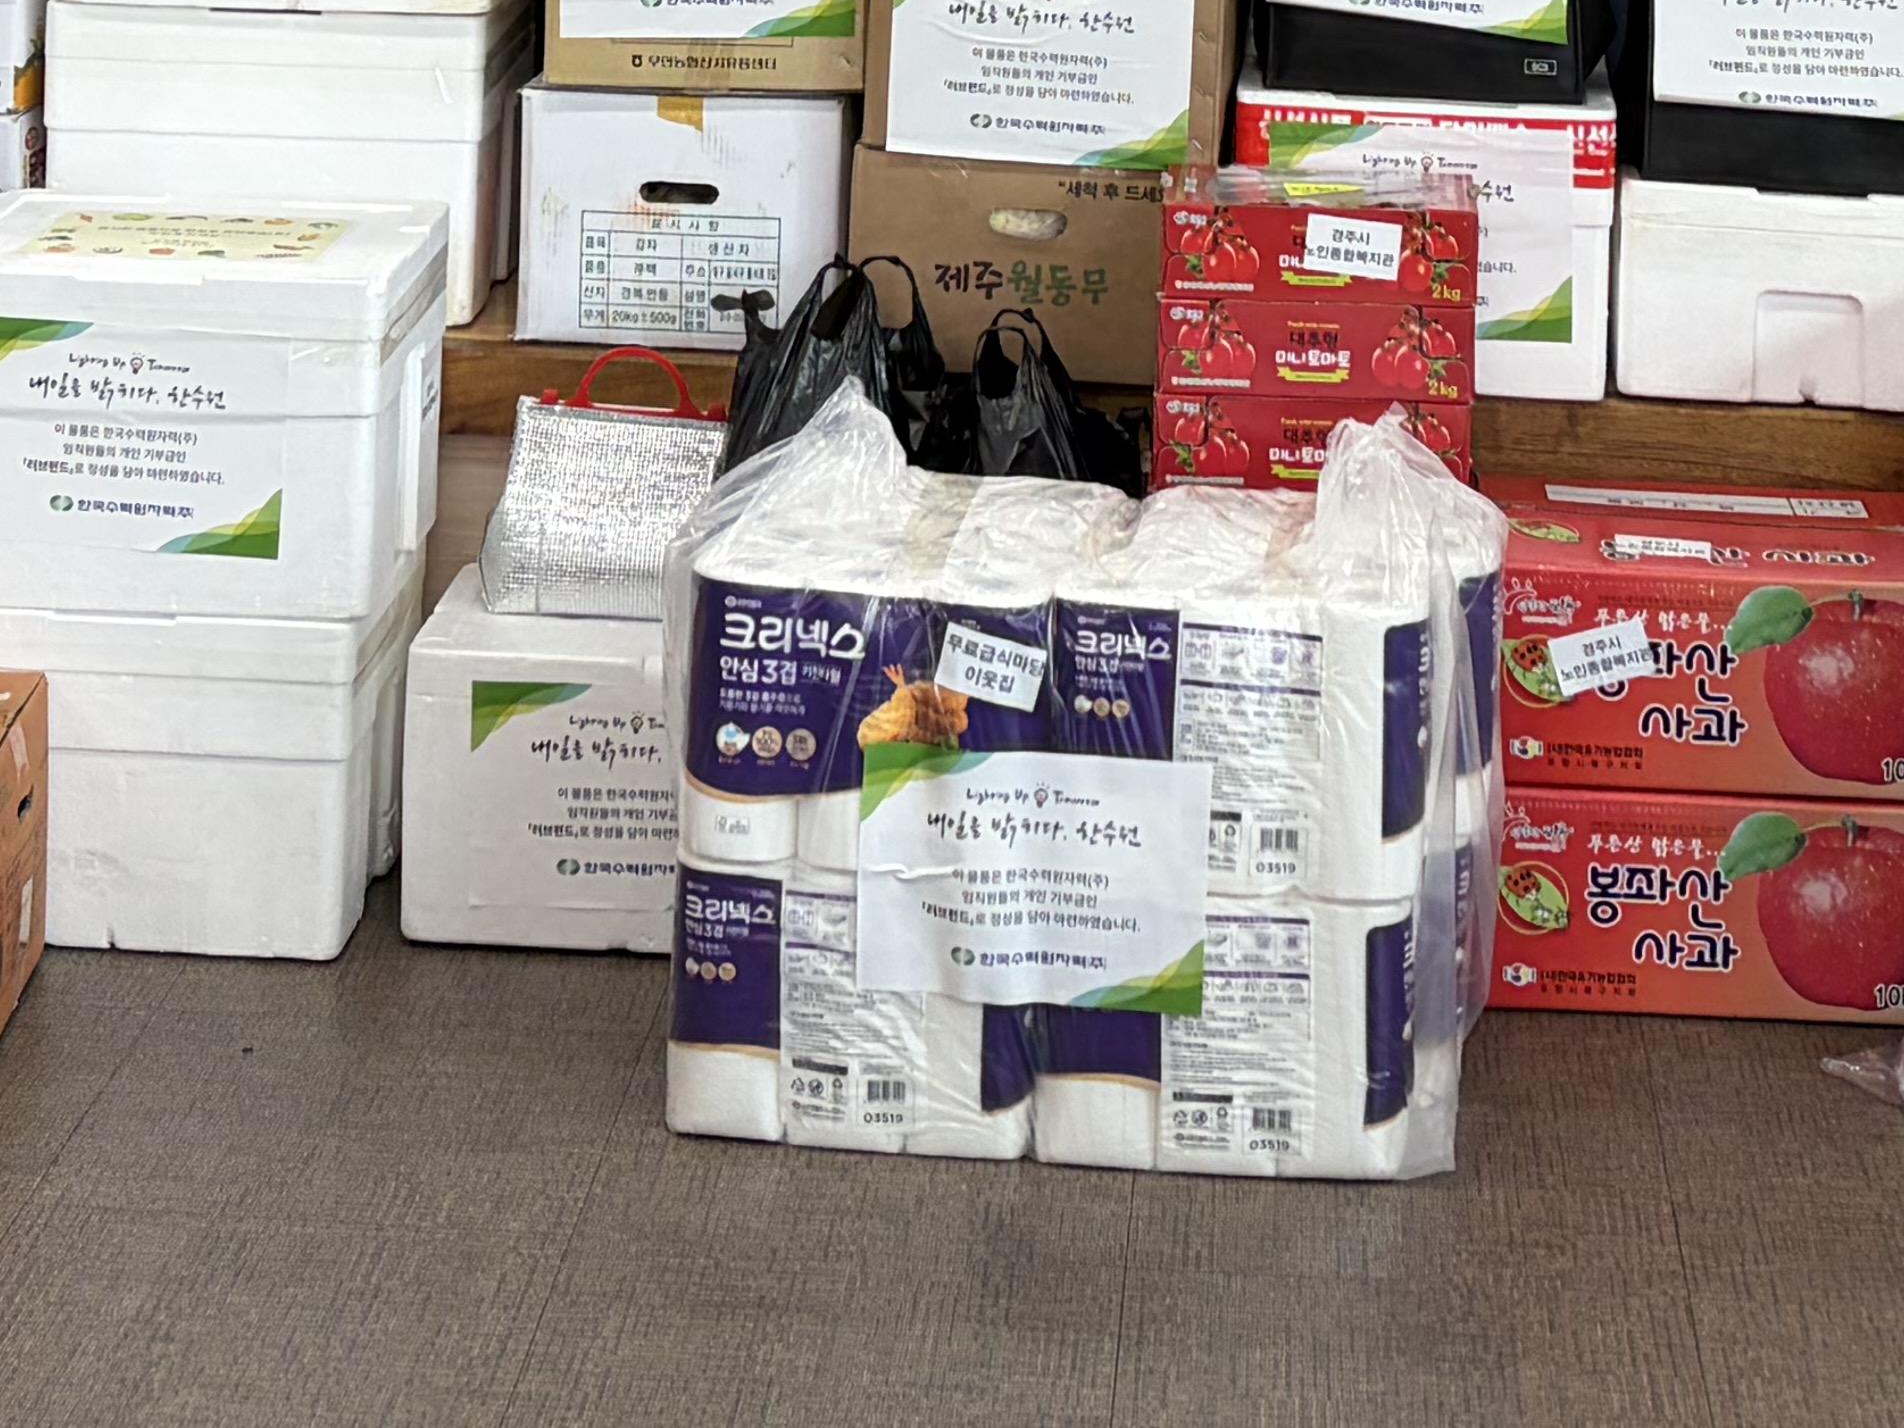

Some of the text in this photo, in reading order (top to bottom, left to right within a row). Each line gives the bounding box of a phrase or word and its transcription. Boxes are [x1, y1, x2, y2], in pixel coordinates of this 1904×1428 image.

[1330, 228, 1371, 244] 경주시
[1430, 282, 1462, 302] 2kg
[1428, 377, 1459, 400] 2kg
[719, 611, 867, 660] 크리넥스
[1074, 628, 1172, 662] 크리넥스
[1581, 636, 1623, 658] 경주시
[947, 631, 1046, 679] 무료급식마당
[964, 665, 1015, 694] 이웃집
[1638, 705, 1747, 745] 사과
[683, 893, 779, 926] 크리넥스
[1586, 862, 1733, 930] 봉좌산
[1632, 929, 1742, 973] 사과
